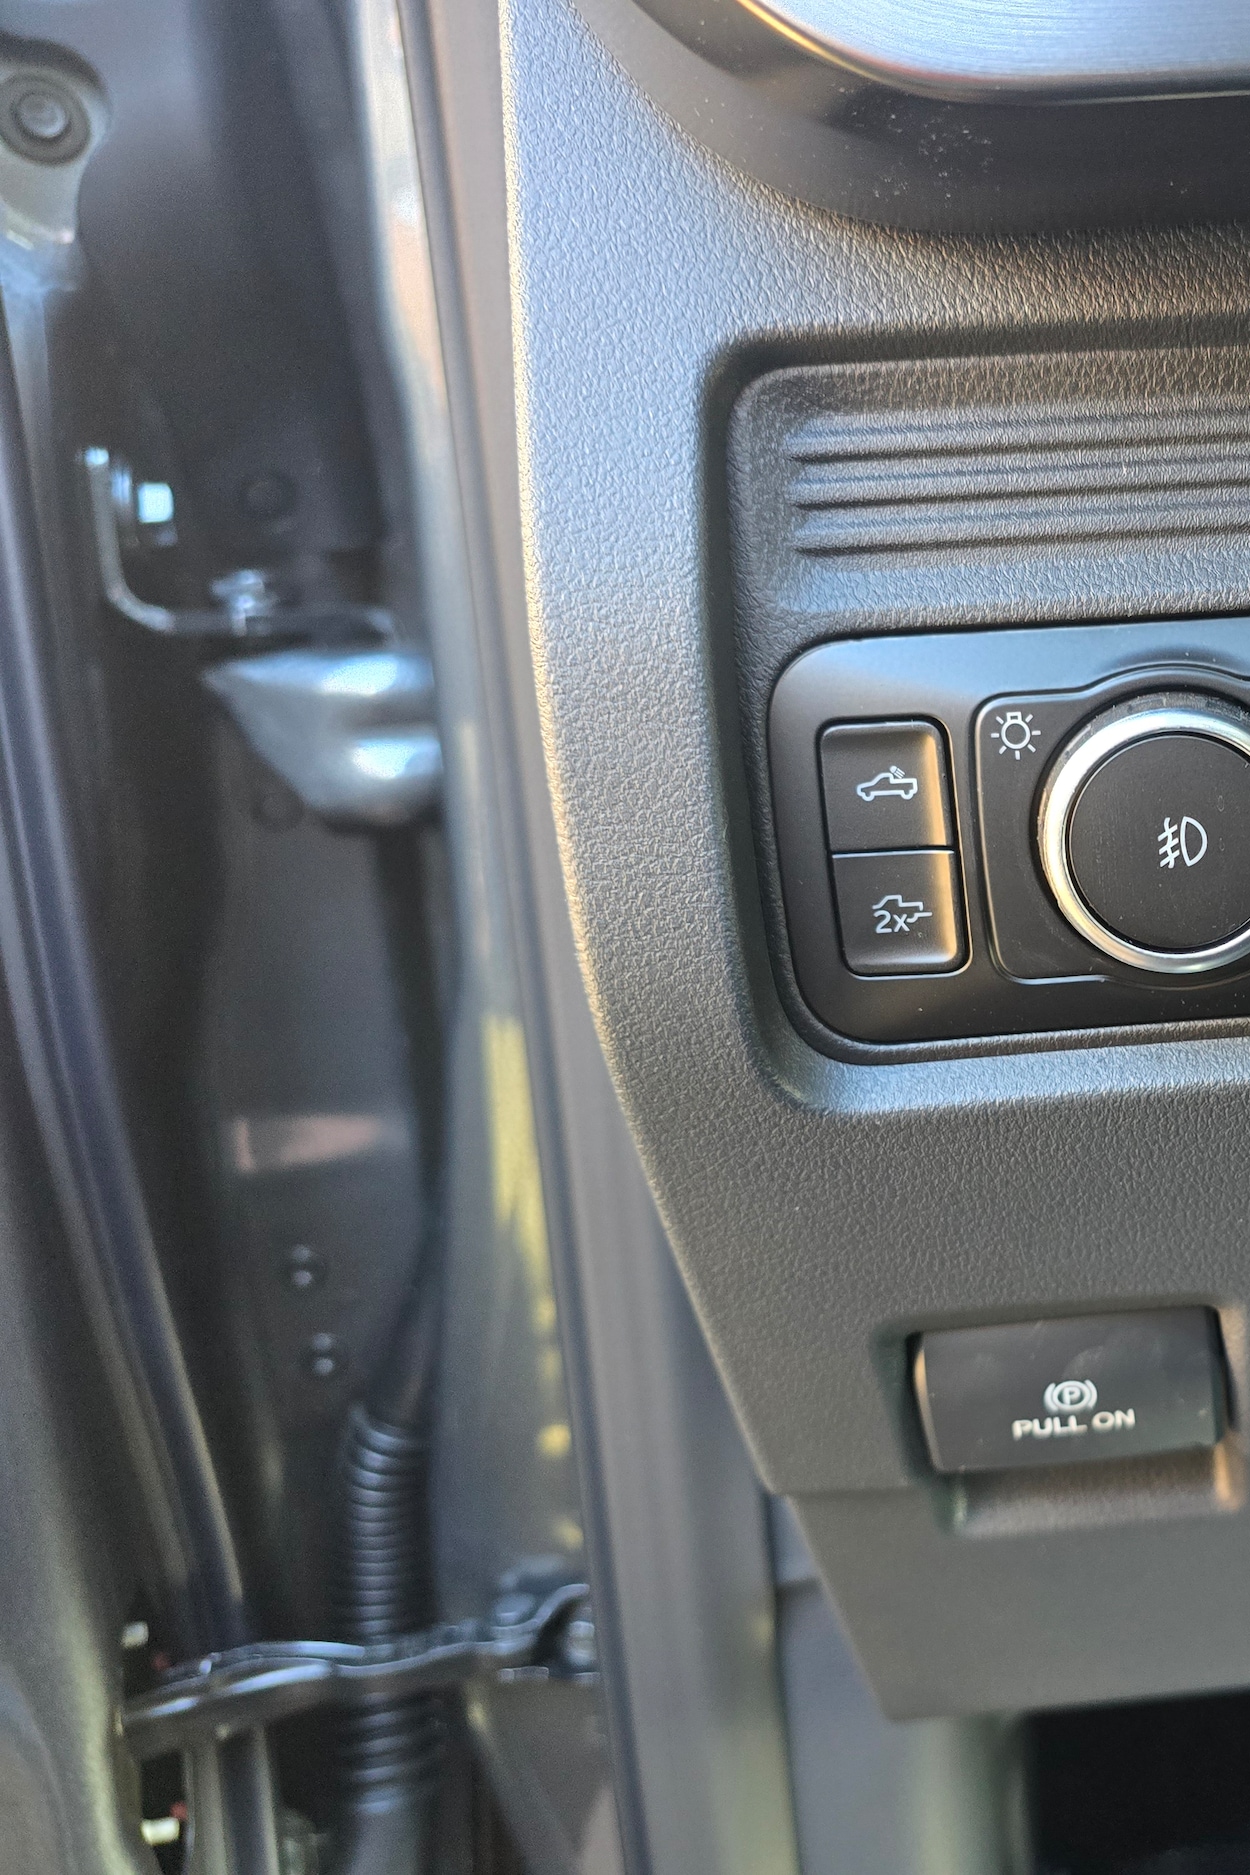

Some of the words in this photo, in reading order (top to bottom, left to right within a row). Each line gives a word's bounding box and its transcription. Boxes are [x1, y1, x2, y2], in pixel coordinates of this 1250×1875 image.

[873, 910, 910, 933] 2x
[1012, 1415, 1088, 1440] PULL
[1091, 1408, 1136, 1431] ON
